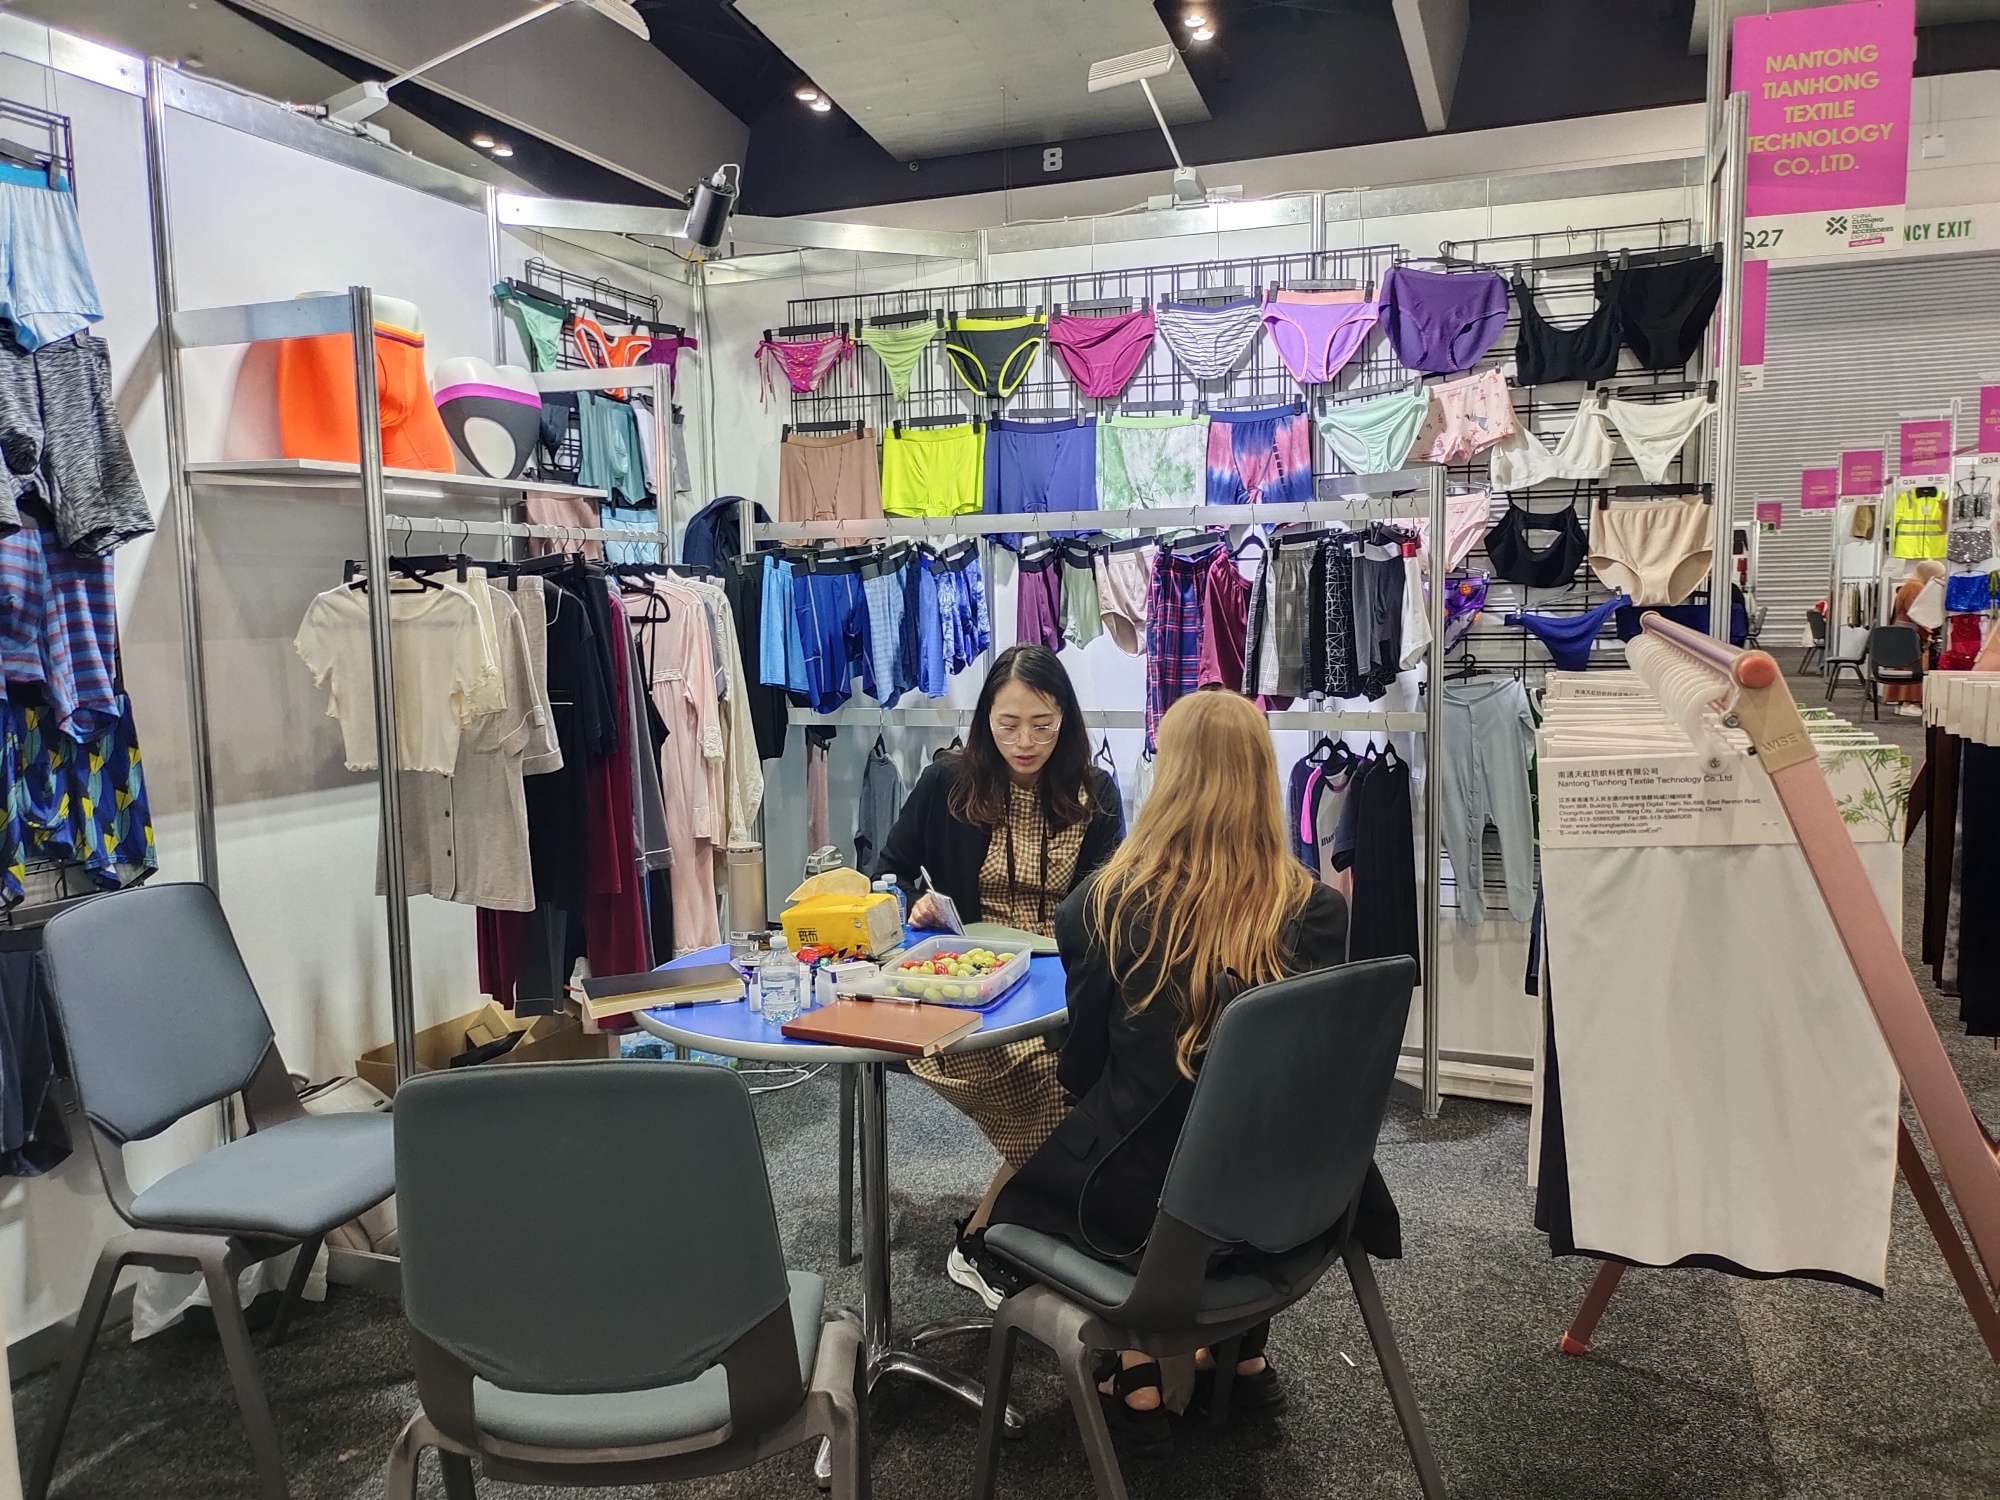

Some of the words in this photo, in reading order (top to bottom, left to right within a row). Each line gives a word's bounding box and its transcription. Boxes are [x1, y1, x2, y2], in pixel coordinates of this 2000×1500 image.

[1765, 44, 1879, 74] NANTONG
[1762, 70, 1880, 100] TIANHONG
[1783, 100, 1855, 124] TEXTILE
[1746, 122, 1894, 154] TECHNOLOGY
[1773, 153, 1860, 177] CO.,LTD.
[1851, 226, 1894, 235] ACCESSORIES
[1852, 217, 1884, 225] CLOTHING
[1936, 219, 1972, 239] EXIT
[1743, 228, 1784, 250] Q27
[1981, 457, 1999, 465] Q34
[1761, 733, 1798, 752] WISE
[1557, 767, 1659, 779] 南通天虹纺织科技有限公司
[1558, 780, 1590, 788] Nantong
[1591, 778, 1628, 787] Tianhong
[1629, 777, 1655, 785] Textile
[1656, 776, 1701, 785] Technology
